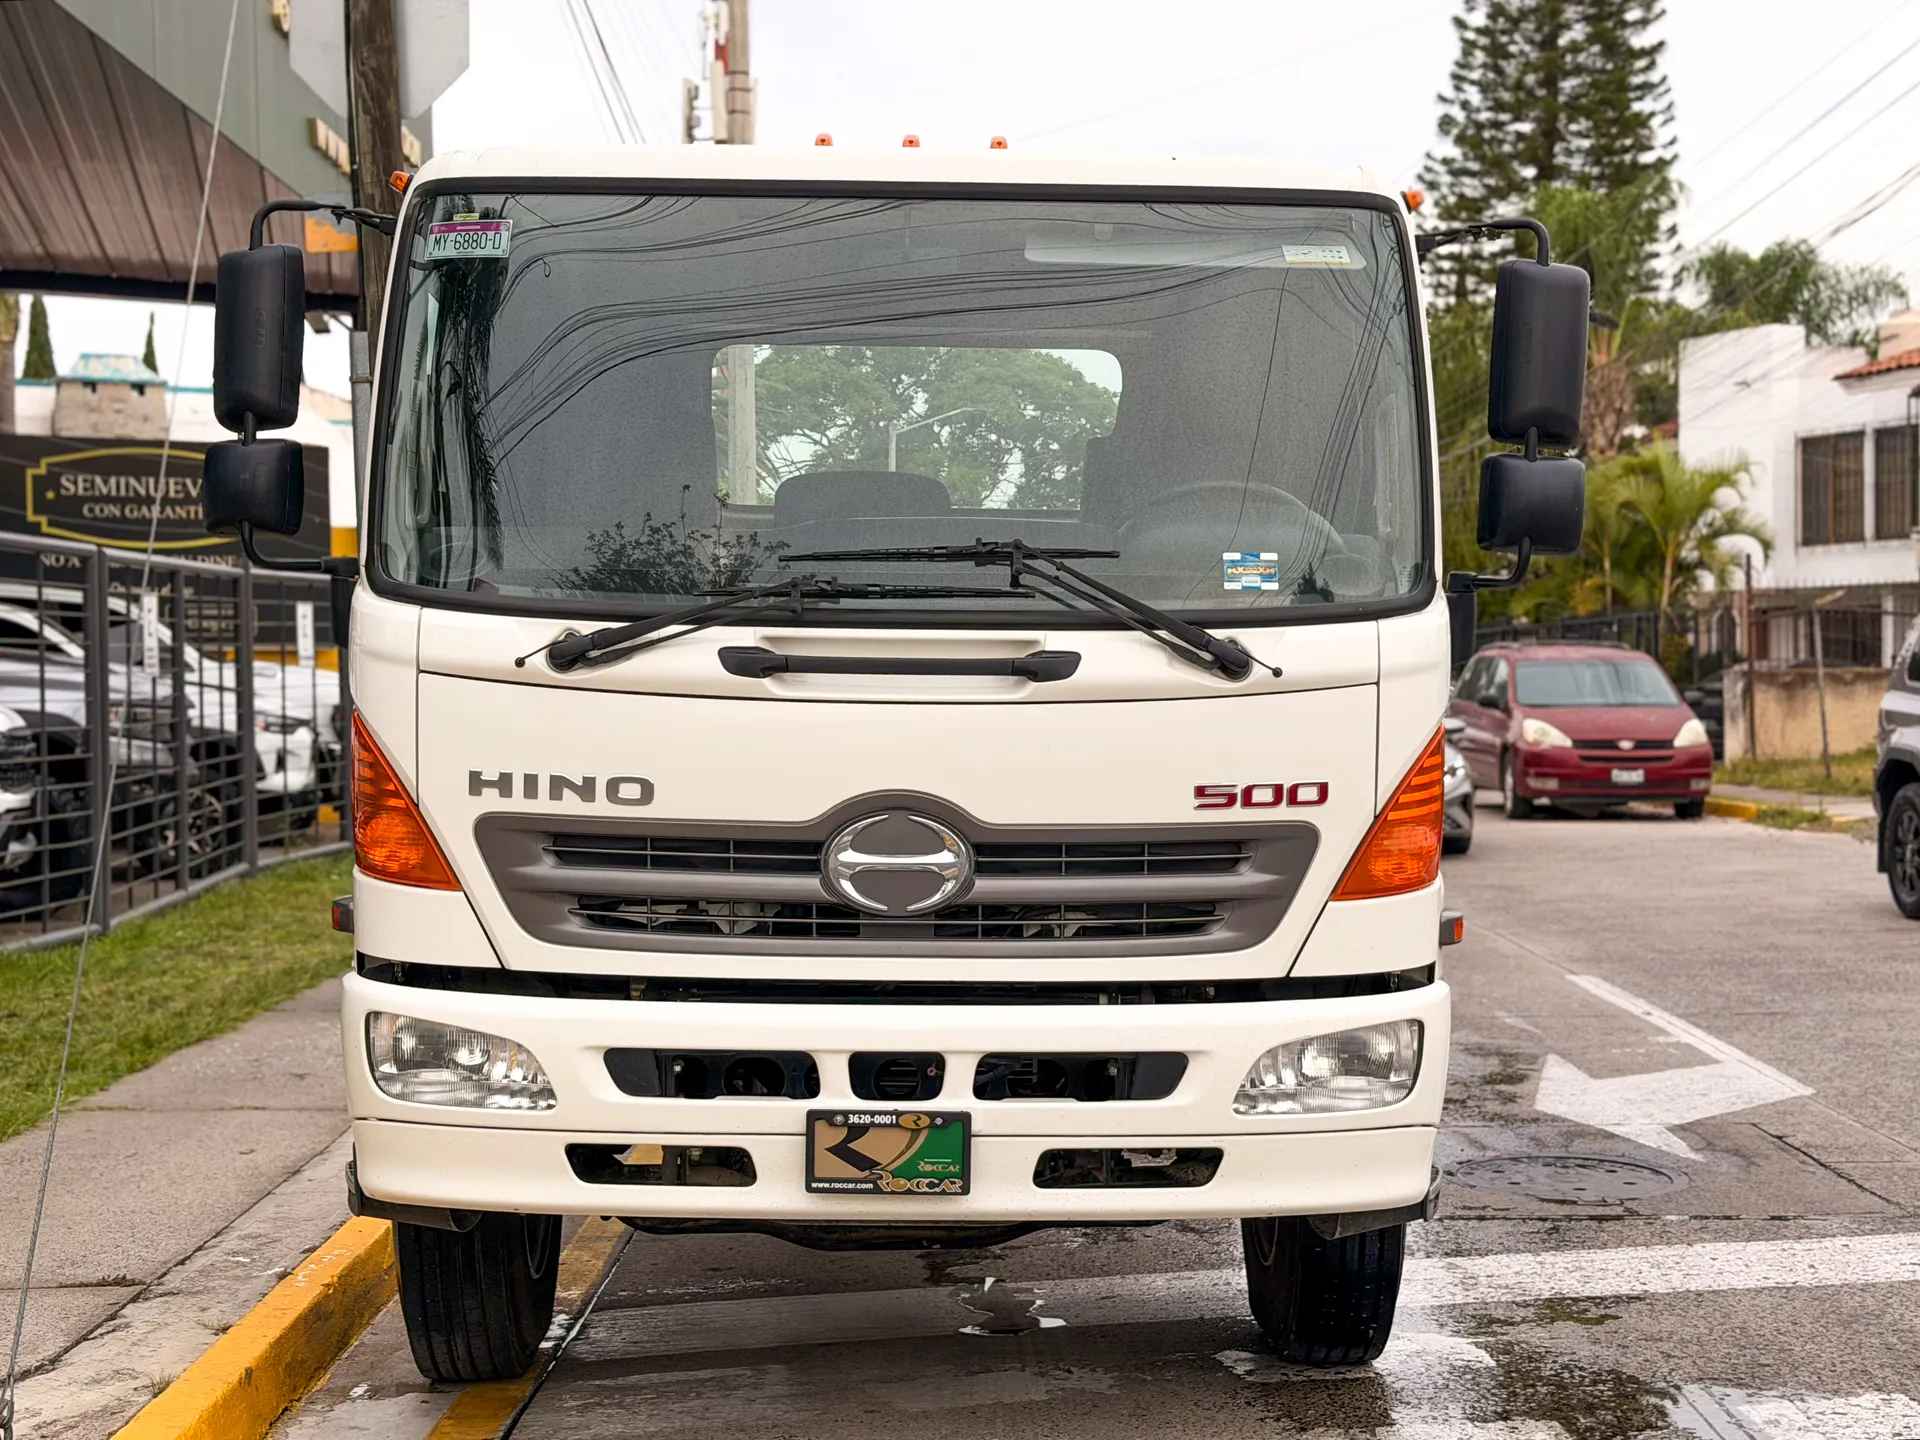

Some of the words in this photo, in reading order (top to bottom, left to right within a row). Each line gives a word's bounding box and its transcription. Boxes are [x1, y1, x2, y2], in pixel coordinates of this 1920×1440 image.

[432, 231, 503, 252] MY-6880-D
[60, 474, 203, 499] SEMINUEV
[82, 502, 121, 518] CON
[468, 770, 655, 807] HINO
[1193, 781, 1329, 811] 500
[847, 1114, 897, 1124] 3620-0001
[811, 1181, 873, 1190] www.roccar.com
